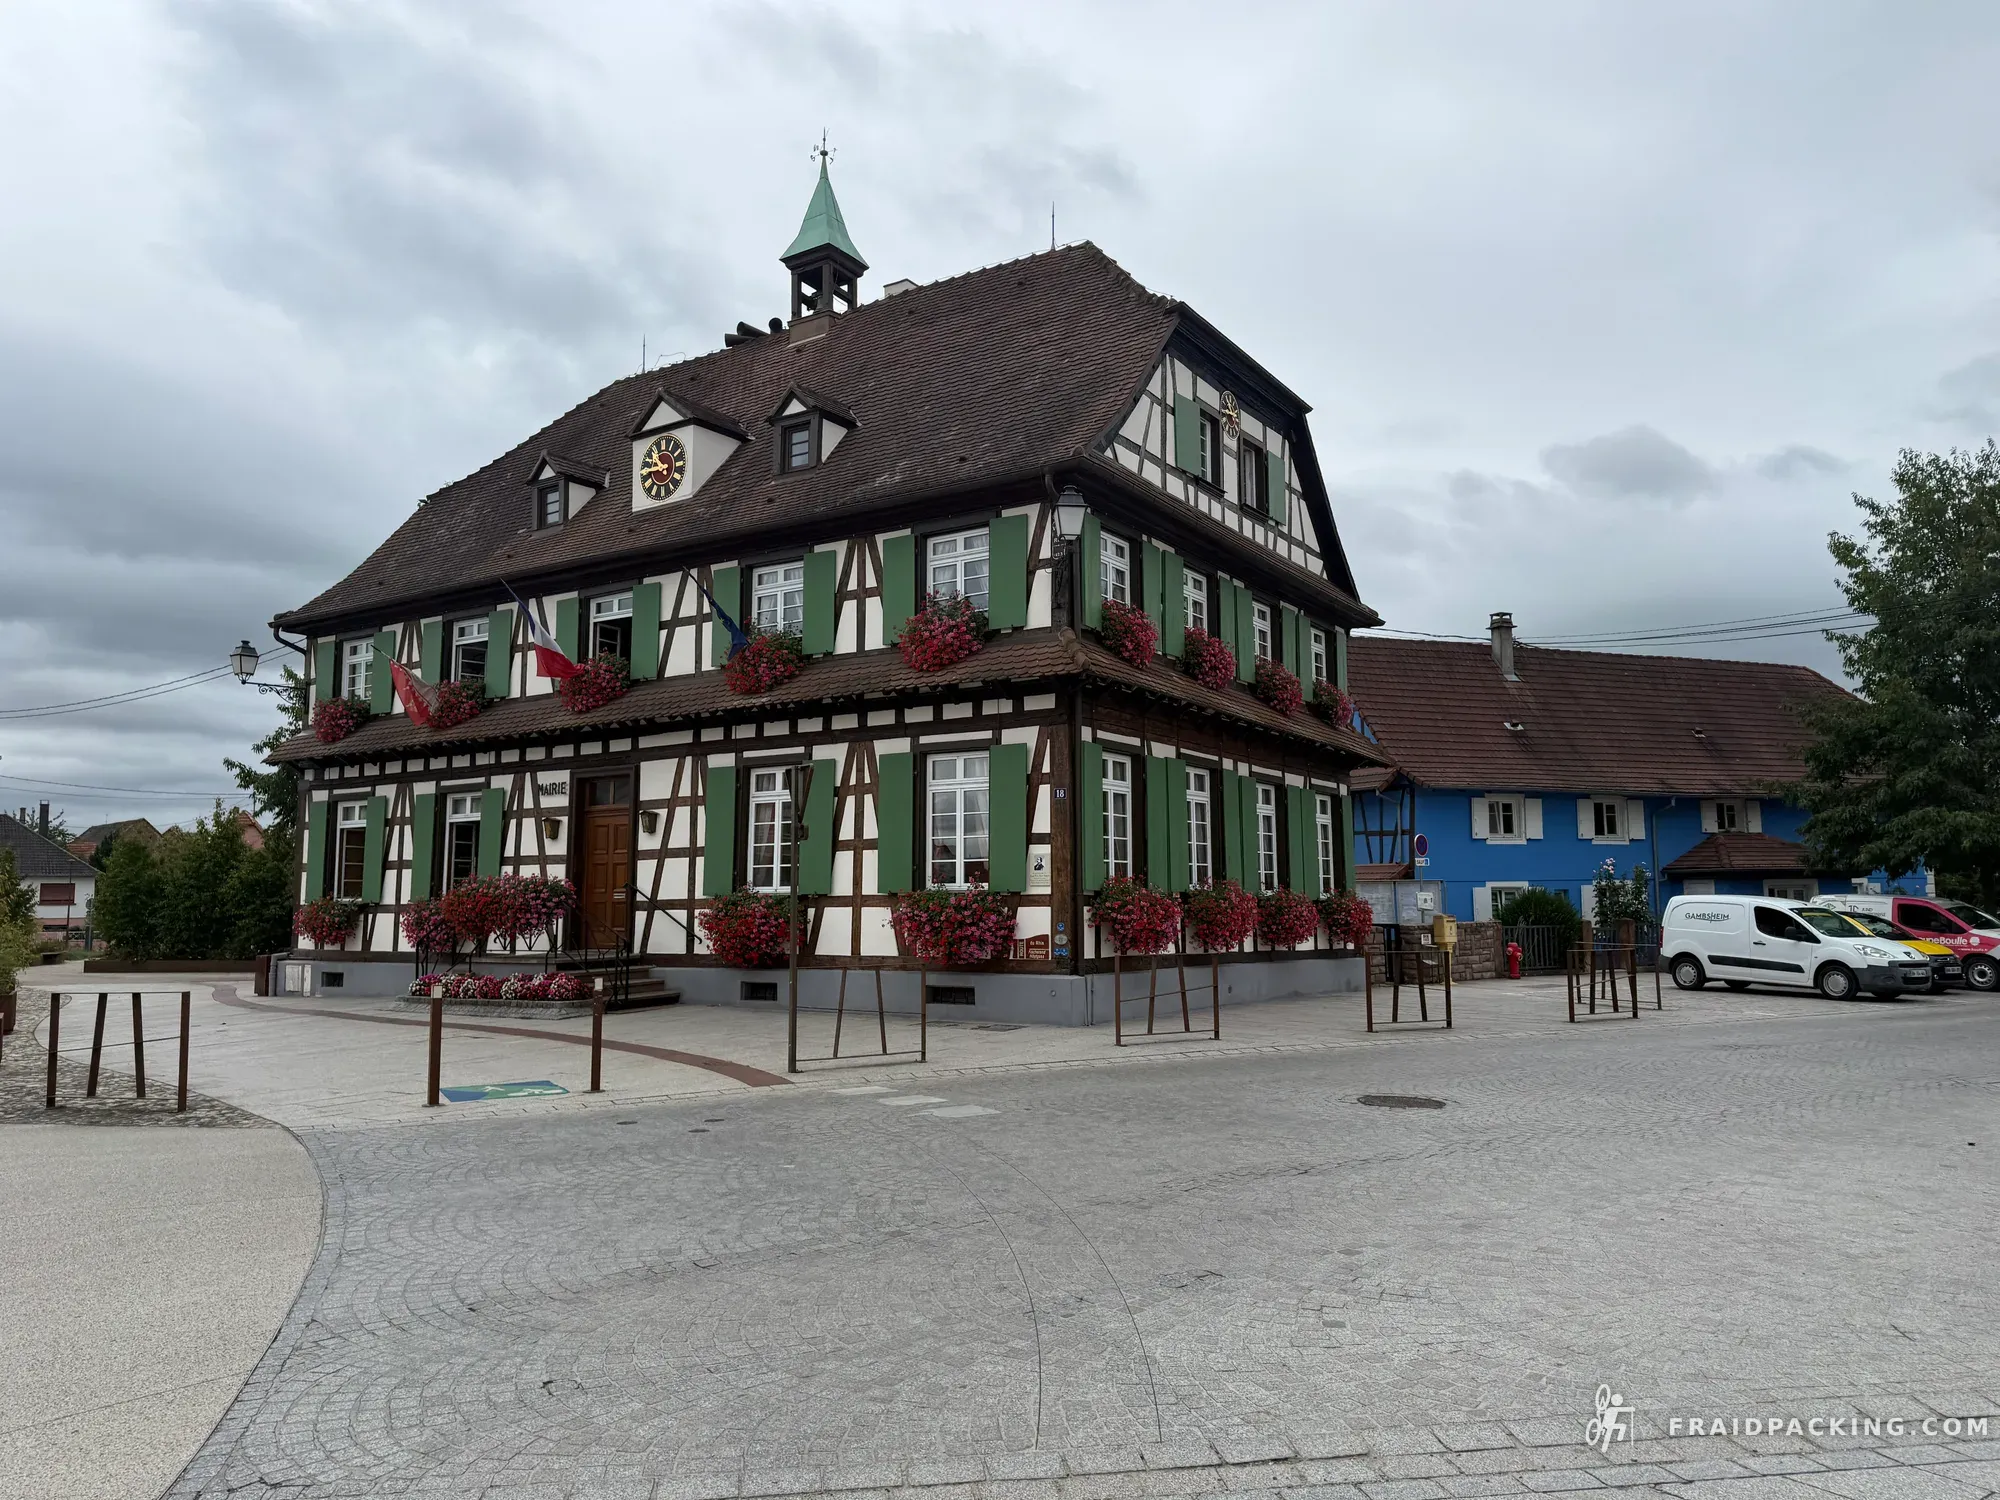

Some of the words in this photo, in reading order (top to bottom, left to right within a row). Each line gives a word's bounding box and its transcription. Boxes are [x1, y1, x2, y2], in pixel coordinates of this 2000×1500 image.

[538, 781, 567, 796] MAIRIE
[1056, 789, 1065, 798] 18
[1685, 912, 1730, 921] GAMBSHEIM
